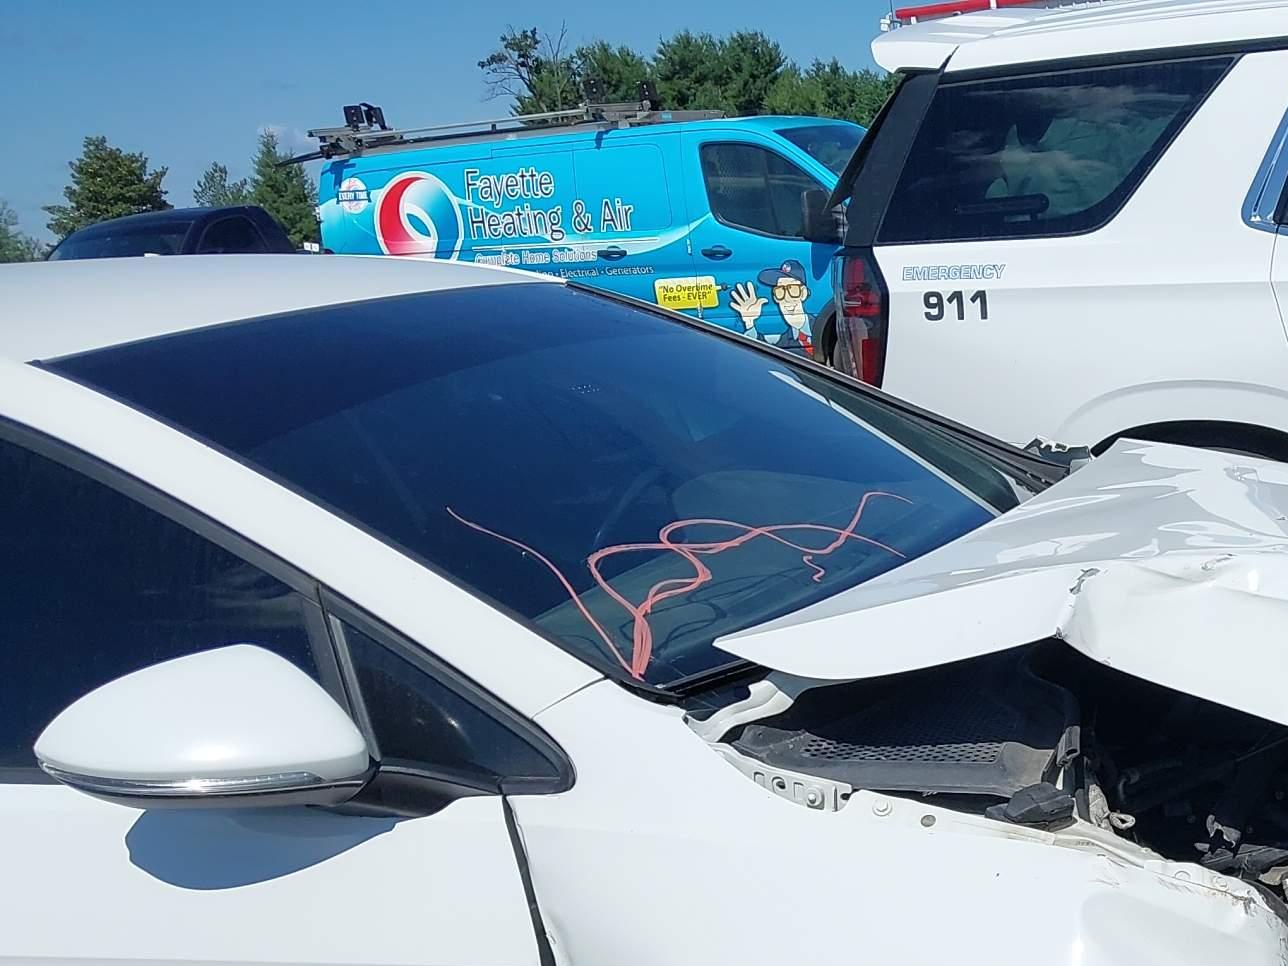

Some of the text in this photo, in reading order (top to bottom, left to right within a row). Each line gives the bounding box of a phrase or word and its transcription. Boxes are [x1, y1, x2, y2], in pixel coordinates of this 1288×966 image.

[465, 167, 554, 207] Fayette
[468, 198, 633, 242] Heating & Air
[522, 251, 550, 265] Home
[552, 249, 597, 263] Solutions
[560, 267, 599, 279] Electrical
[605, 265, 654, 276] Generators
[902, 264, 1006, 281] EMERGENCY
[677, 283, 713, 293] Overtime
[663, 293, 681, 302] Fees
[923, 290, 988, 321] 911
